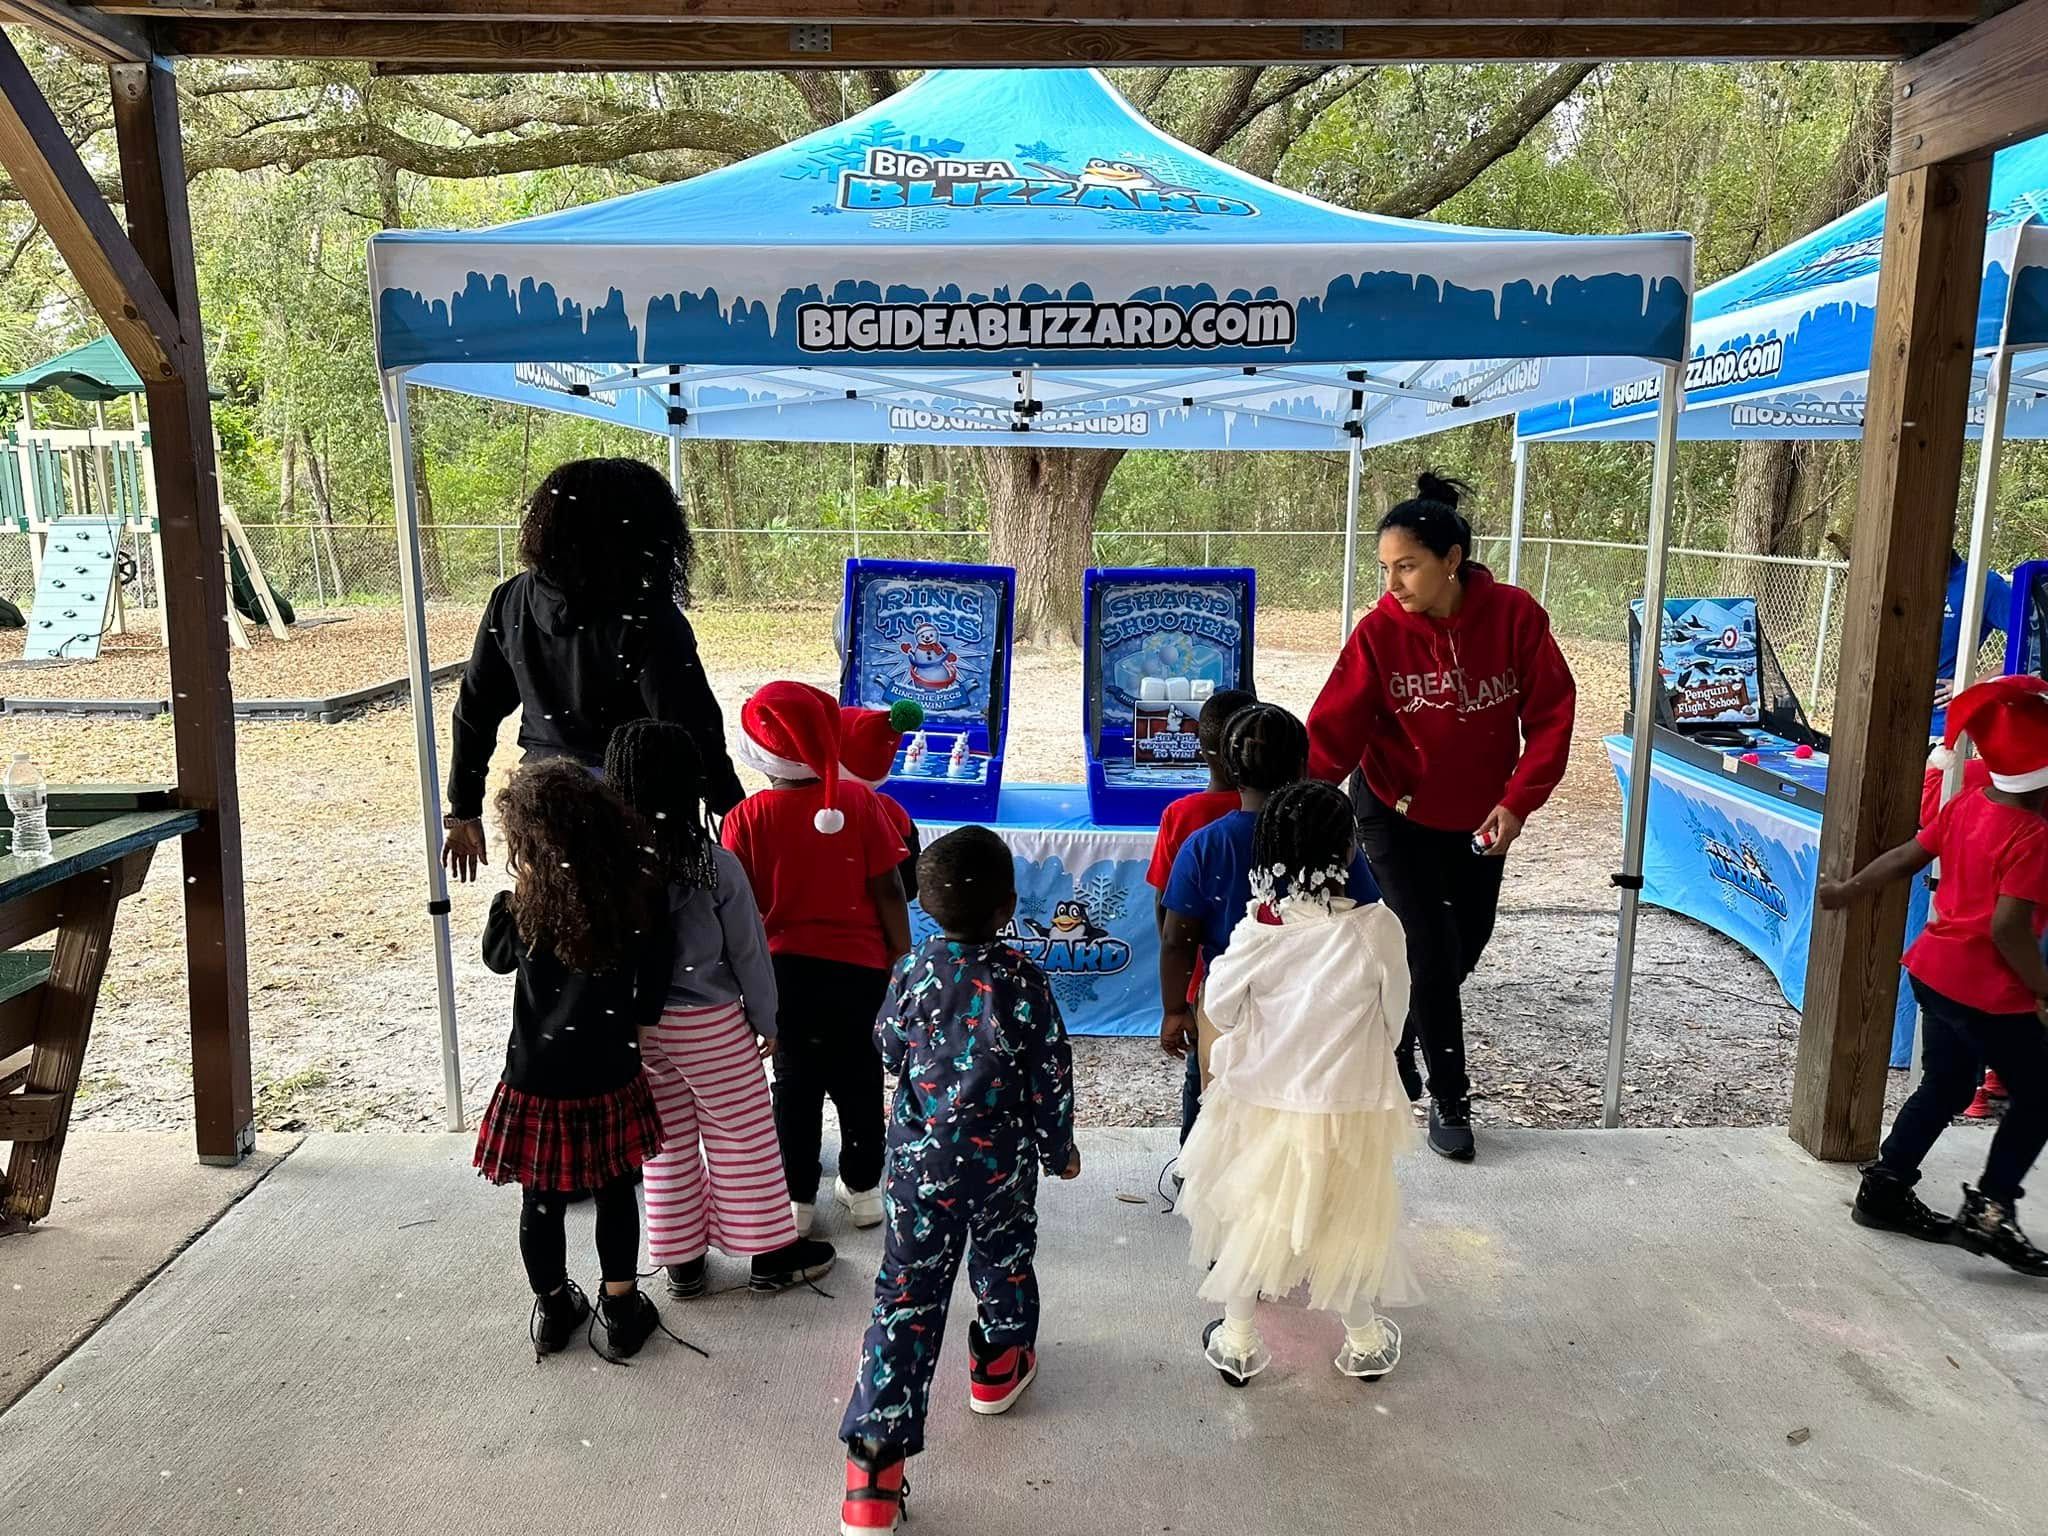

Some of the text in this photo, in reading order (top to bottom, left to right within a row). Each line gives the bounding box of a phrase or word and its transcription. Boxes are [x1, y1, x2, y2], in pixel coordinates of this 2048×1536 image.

[873, 151, 1010, 179] BIG IDEA
[846, 178, 1257, 216] BLIZZARD
[802, 304, 1291, 347] BIGIDEABLIZZARD.com
[1612, 340, 1782, 406] BIGIDEAZZARD.com
[880, 585, 982, 615] RING
[1109, 590, 1230, 618] SHARP
[879, 610, 982, 642] TOSS
[1100, 612, 1239, 647] SHOOTER
[891, 686, 962, 701] RING THE PEGS
[1389, 667, 1518, 706] GREAT LAND
[1466, 688, 1520, 713] ALASKA
[1684, 685, 1729, 700] Penguin
[1677, 695, 1740, 715] Flight School
[1138, 741, 1201, 750] CENTER CUB
[1154, 732, 1196, 741] HIT THE
[1154, 749, 1169, 759] TO
